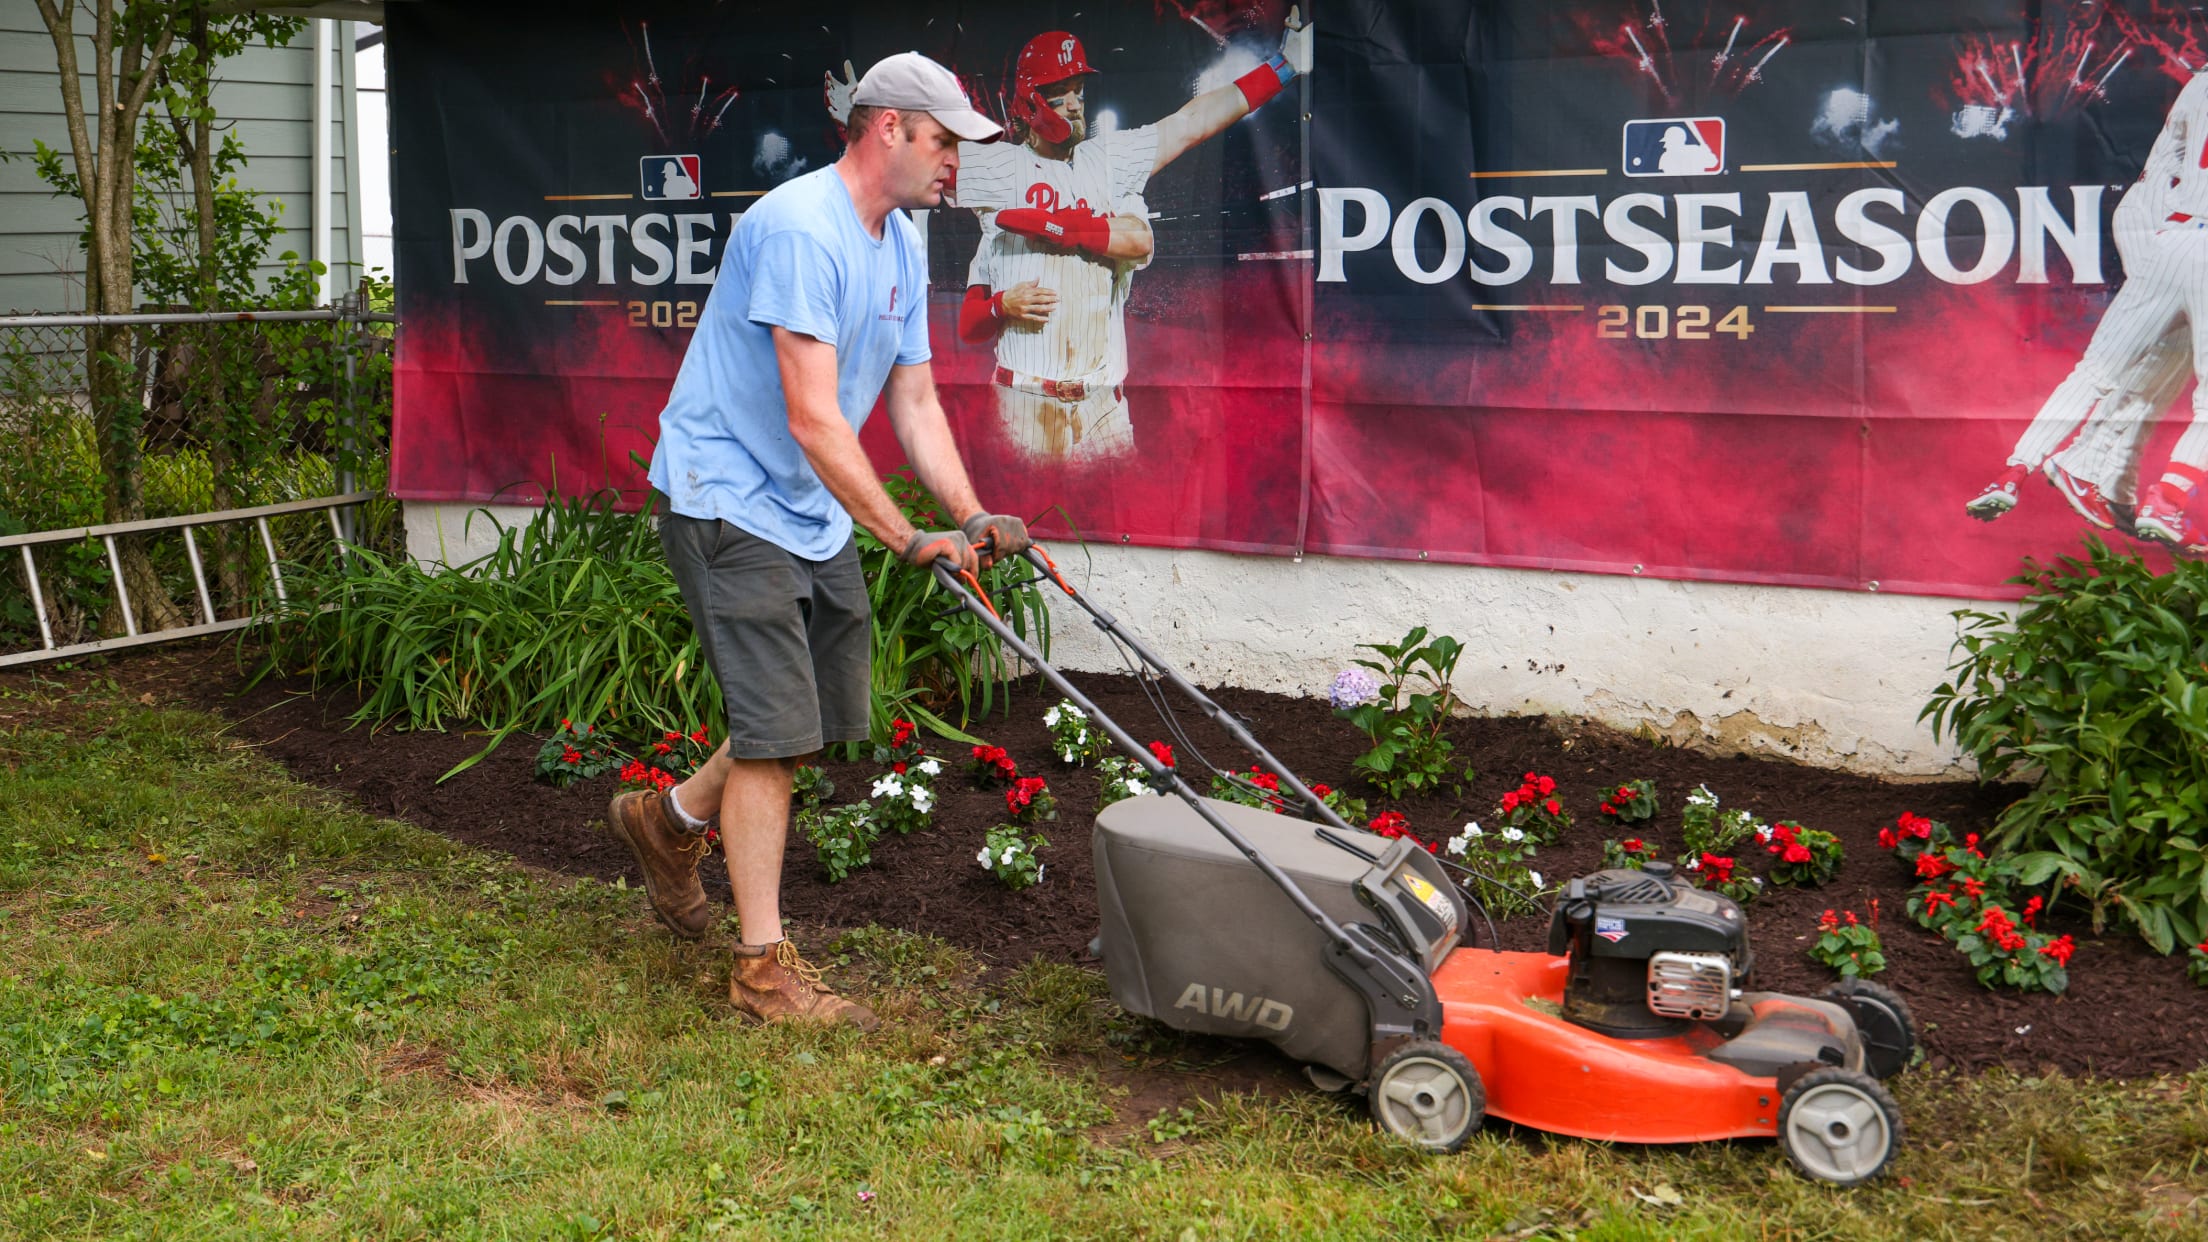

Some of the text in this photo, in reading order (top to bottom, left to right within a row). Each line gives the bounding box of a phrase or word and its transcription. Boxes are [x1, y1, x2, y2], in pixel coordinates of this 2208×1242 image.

[449, 208, 745, 286] POSTSE
[1316, 186, 2105, 286] POSTSEASON
[627, 301, 700, 328] 202
[1597, 305, 1755, 340] 2024
[1173, 982, 1294, 1032] AWD
